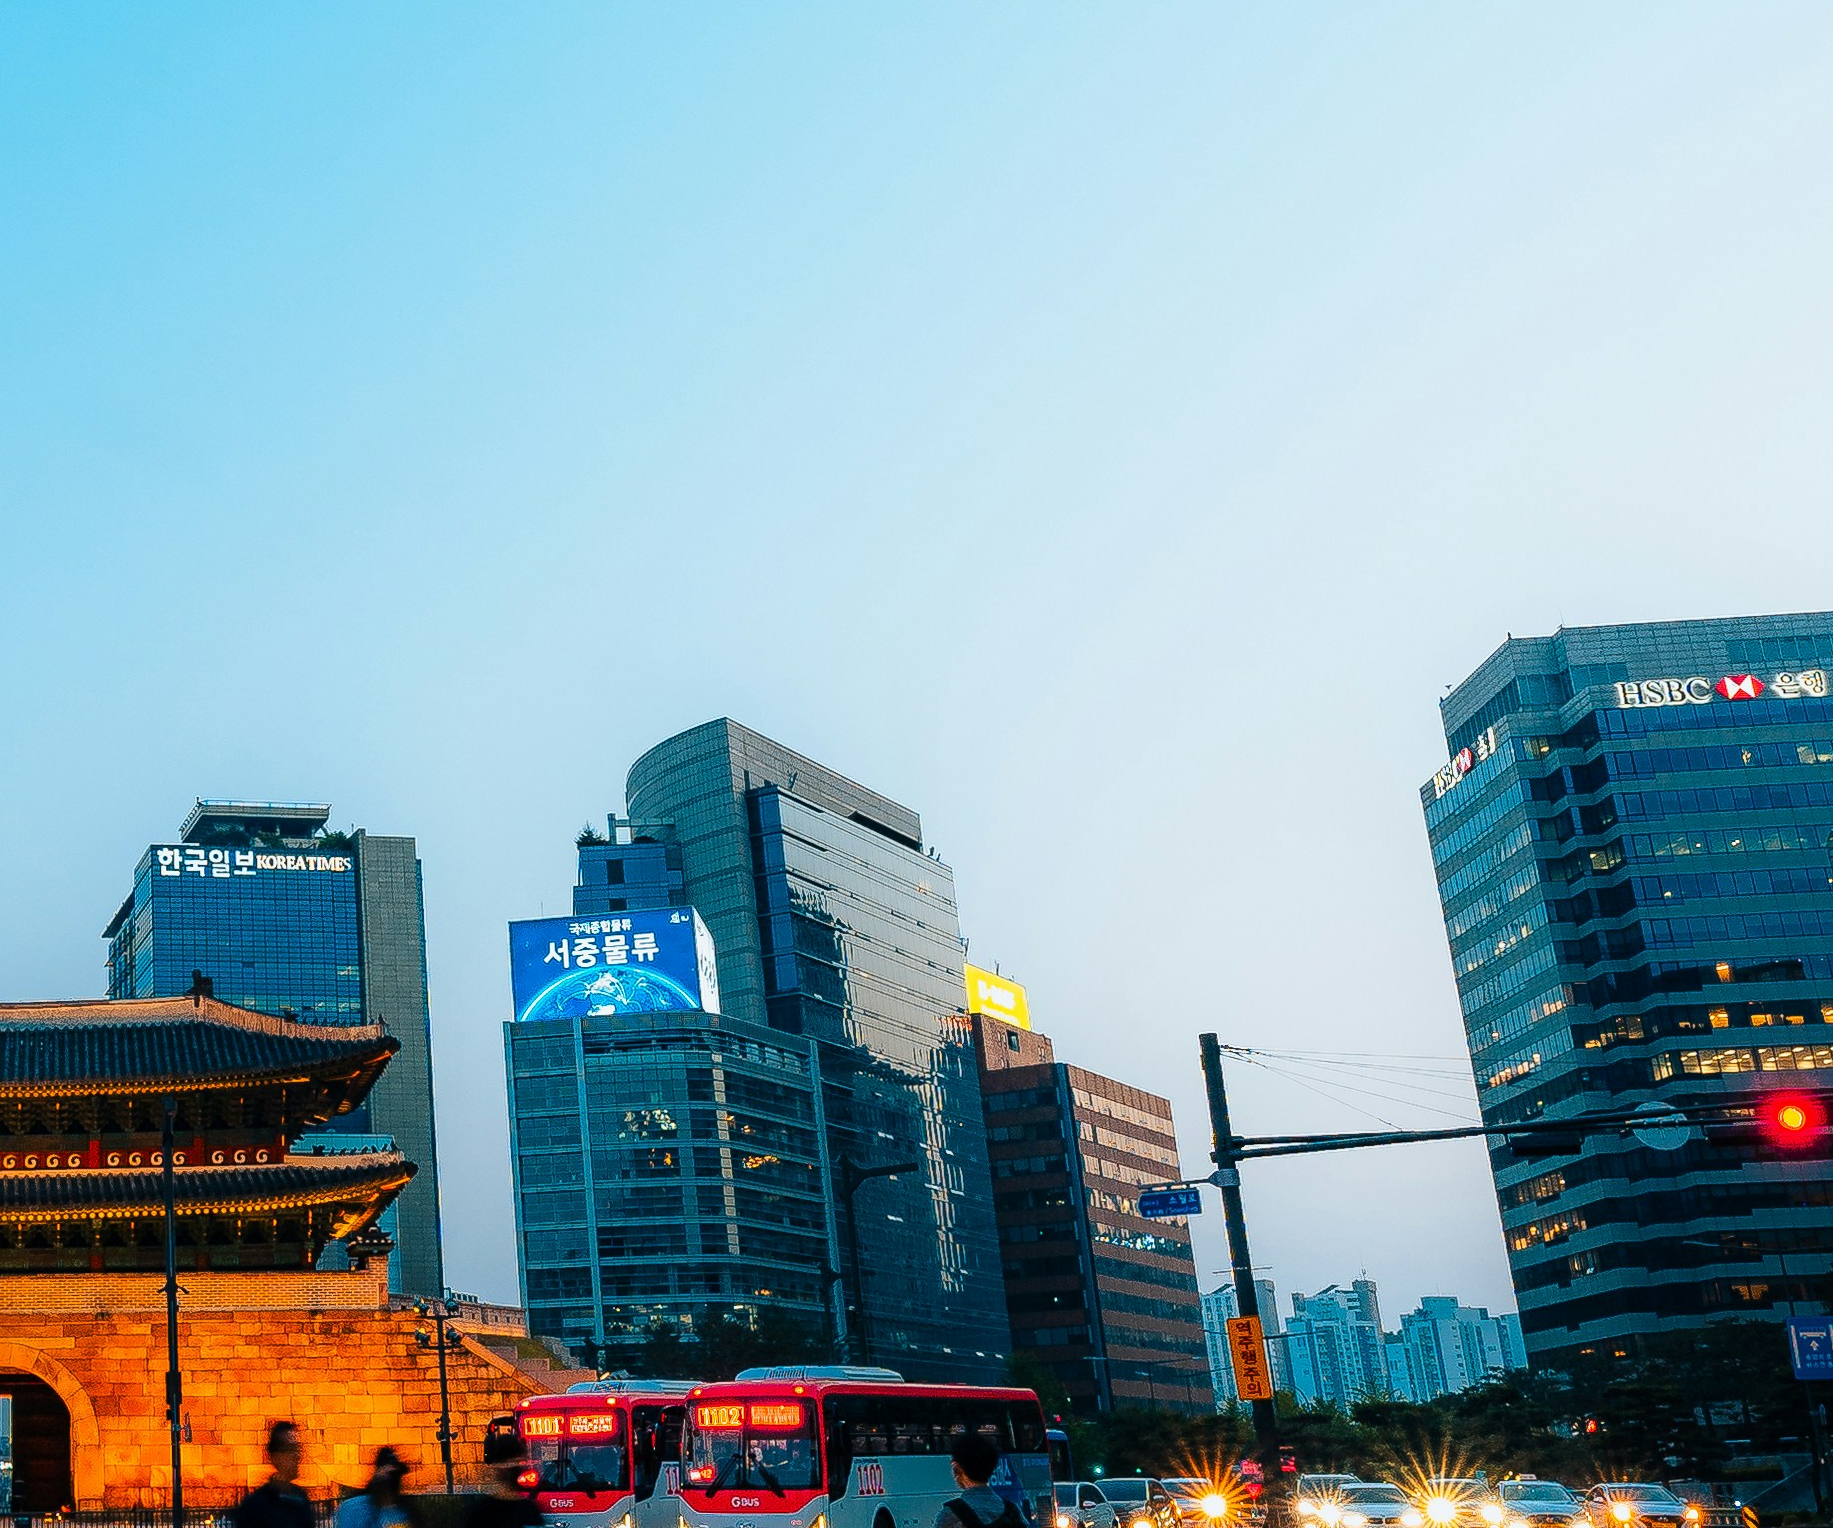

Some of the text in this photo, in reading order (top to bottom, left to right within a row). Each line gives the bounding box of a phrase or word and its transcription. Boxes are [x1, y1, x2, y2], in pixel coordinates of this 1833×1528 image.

[1617, 670, 1828, 707] HSBC 은행
[156, 847, 257, 878] 한국일보
[568, 918, 632, 936] 국제종합물류
[543, 932, 660, 969] 서중물류
[1236, 1320, 1263, 1396] 역주행주의
[703, 1408, 741, 1426] 1102
[857, 1464, 885, 1496] 1102
